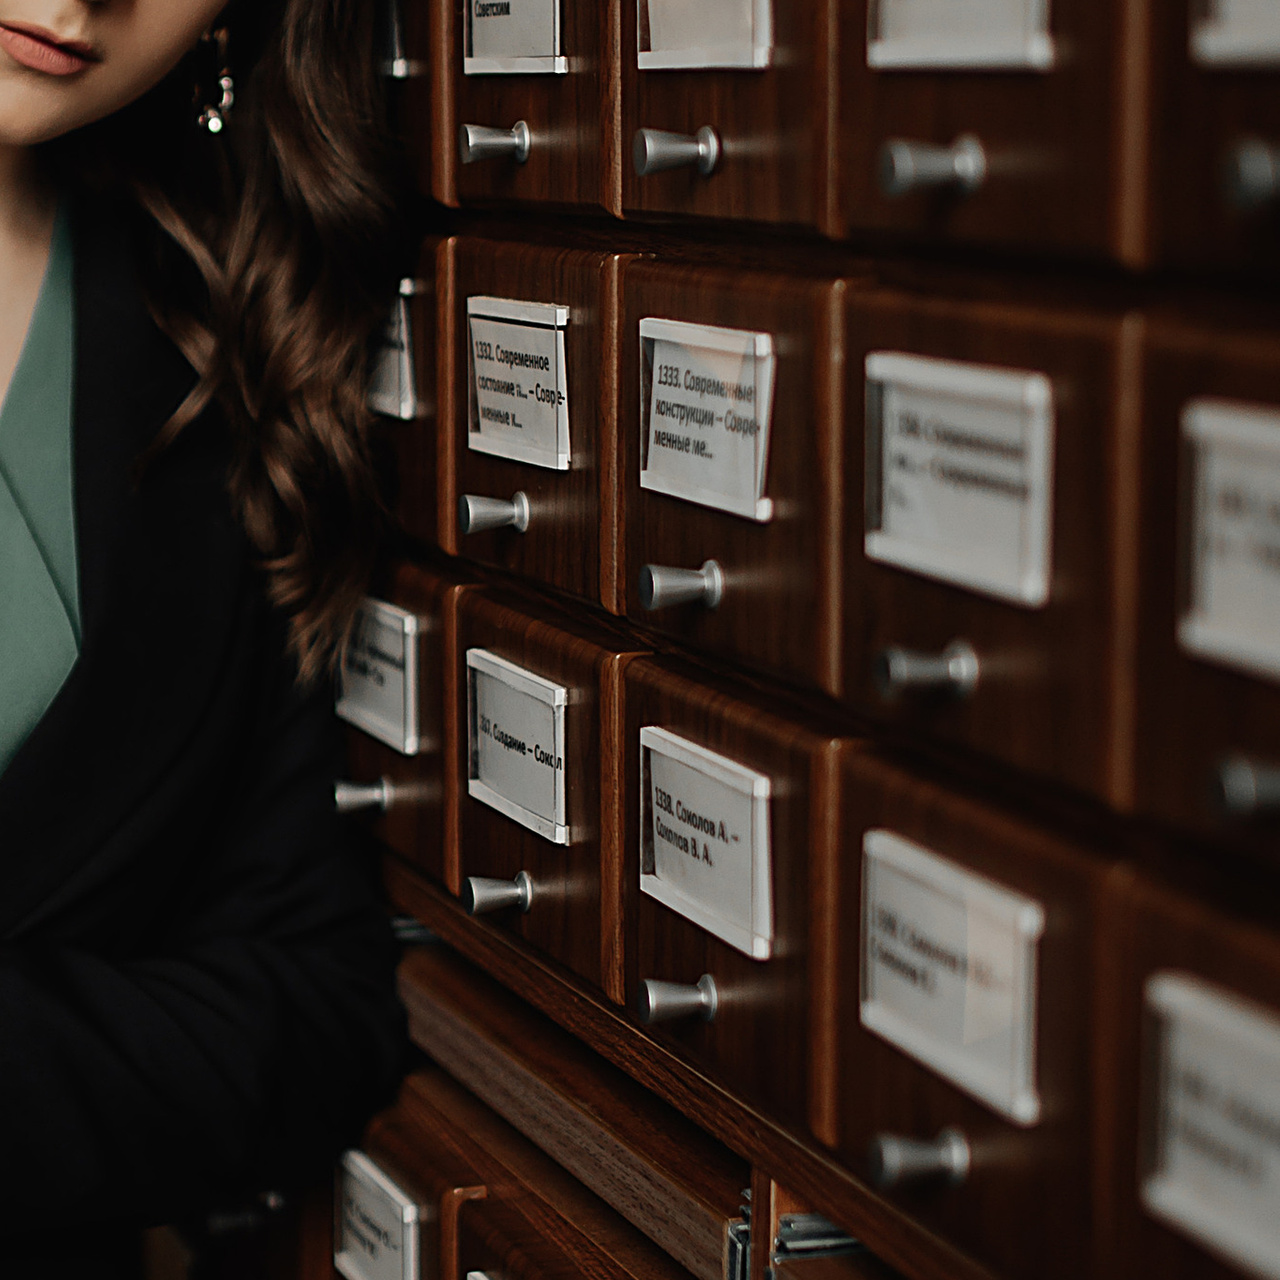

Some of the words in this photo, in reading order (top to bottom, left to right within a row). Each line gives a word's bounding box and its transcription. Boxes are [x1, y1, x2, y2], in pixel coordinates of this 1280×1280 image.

[474, 0, 511, 18] Советским
[475, 340, 495, 361] 1332.
[495, 343, 550, 371] Современное
[477, 375, 515, 397] состояние
[657, 363, 682, 389] 1333.
[683, 369, 754, 402] Современные
[480, 405, 510, 426] менные
[655, 398, 715, 429] конструкции
[653, 429, 691, 454] менные
[493, 723, 527, 756] Создание
[655, 786, 675, 816] 1338.
[676, 799, 716, 837] Соколов
[718, 820, 729, 844] А.
[656, 815, 689, 854] Соколов
[702, 842, 714, 867] А.
